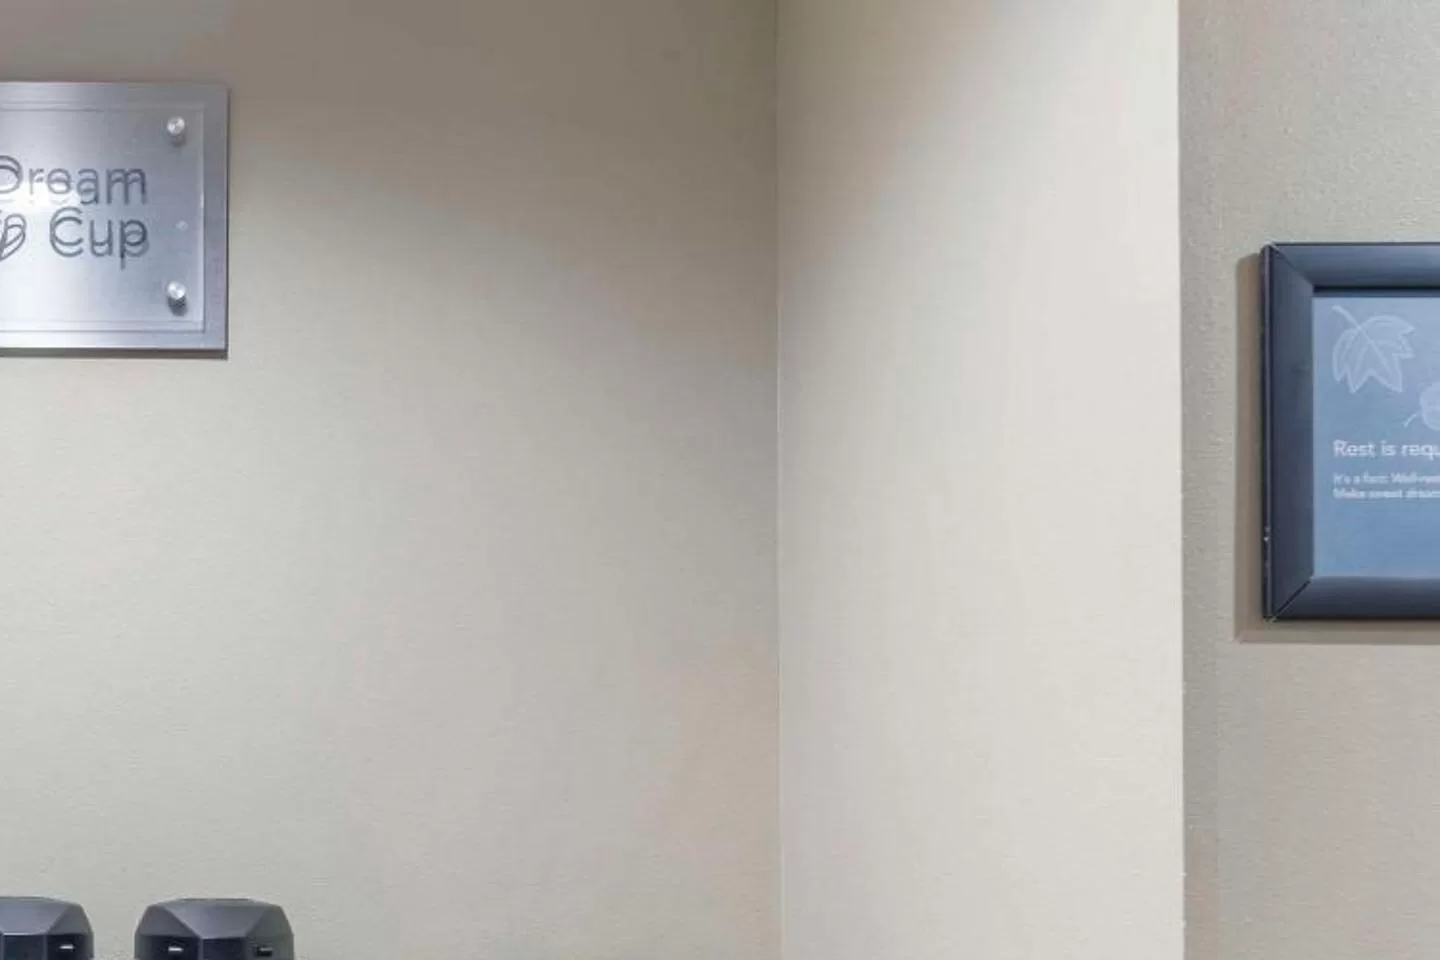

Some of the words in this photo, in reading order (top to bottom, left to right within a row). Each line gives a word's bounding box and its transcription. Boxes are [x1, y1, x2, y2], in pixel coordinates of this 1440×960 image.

[49, 206, 148, 270] Cup
[1333, 440, 1376, 458] Rest
[1380, 440, 1396, 457] is
